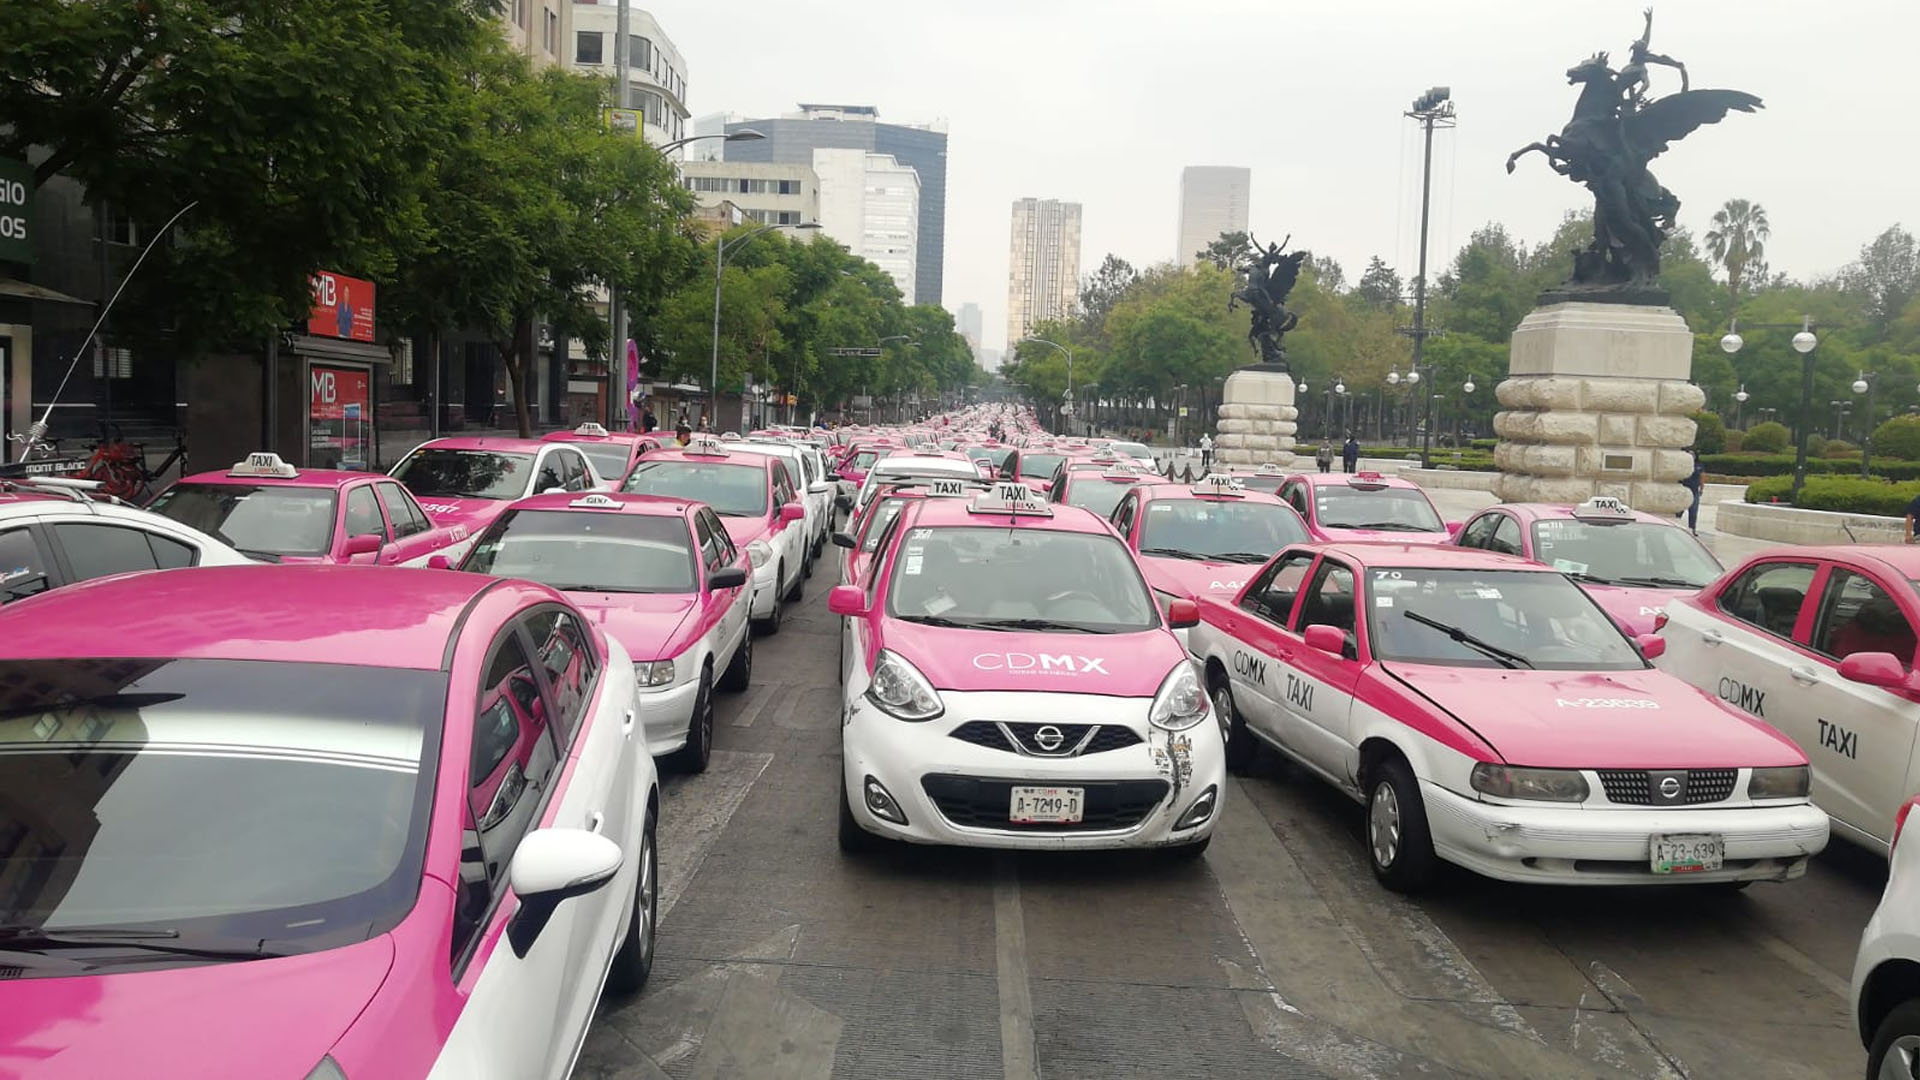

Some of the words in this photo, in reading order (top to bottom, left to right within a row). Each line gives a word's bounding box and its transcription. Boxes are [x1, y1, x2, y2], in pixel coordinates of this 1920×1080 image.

[311, 371, 336, 403] MB
[698, 440, 716, 448] TAXI
[251, 455, 273, 467] TAXI
[934, 481, 962, 495] TAXI
[1210, 477, 1230, 487] TAXI
[1000, 486, 1026, 501] TAXI
[1595, 500, 1618, 510] TAXI
[972, 652, 1109, 676] CDMX
[1234, 650, 1267, 686] CDMX
[1286, 672, 1314, 712] TAXI
[1719, 677, 1765, 717] CDMX
[1818, 718, 1857, 760] TAXI
